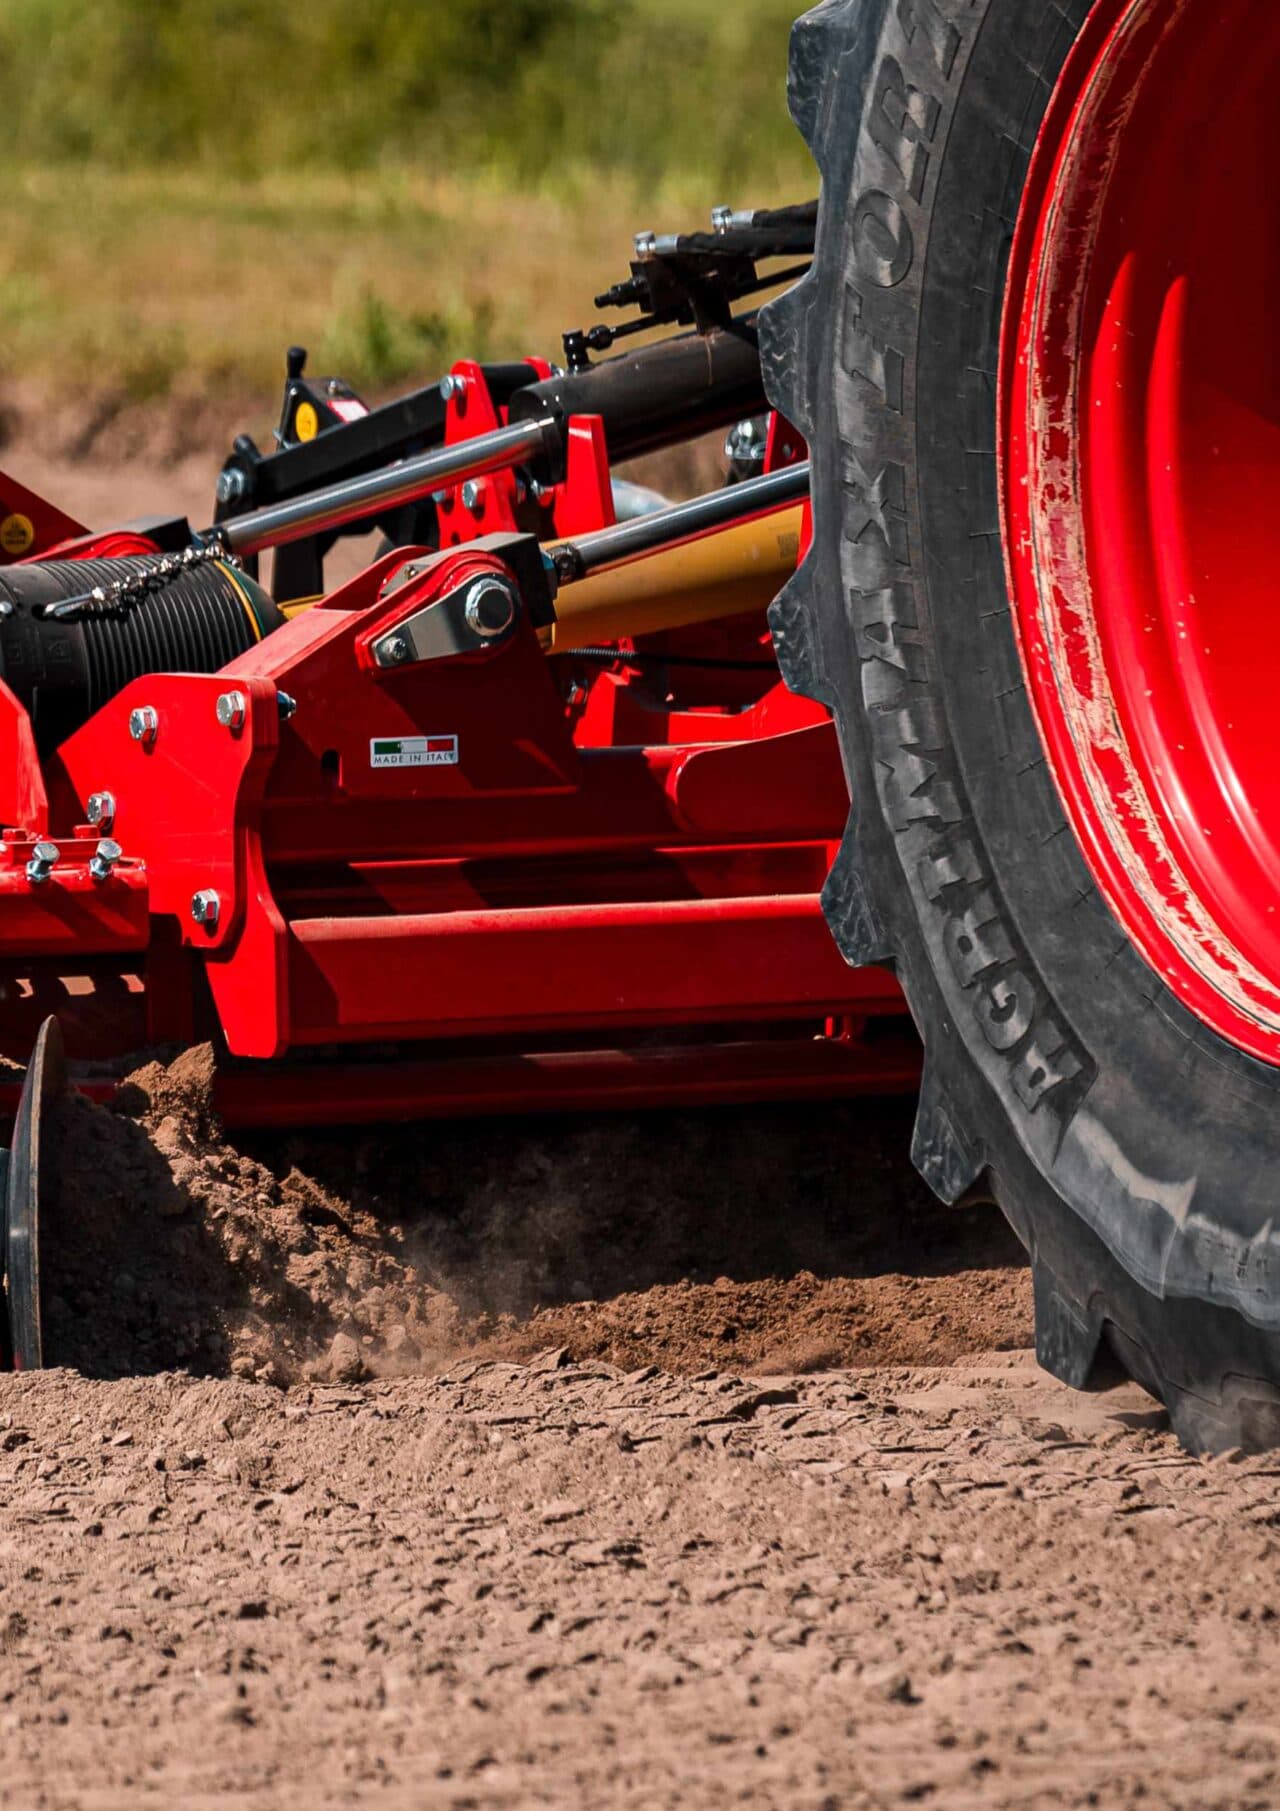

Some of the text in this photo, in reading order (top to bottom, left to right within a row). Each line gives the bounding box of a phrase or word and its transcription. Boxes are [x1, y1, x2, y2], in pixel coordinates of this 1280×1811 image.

[374, 752, 455, 764] MADE IN ITALY
[841, 0, 1086, 1113] AGRIMAX FORT
